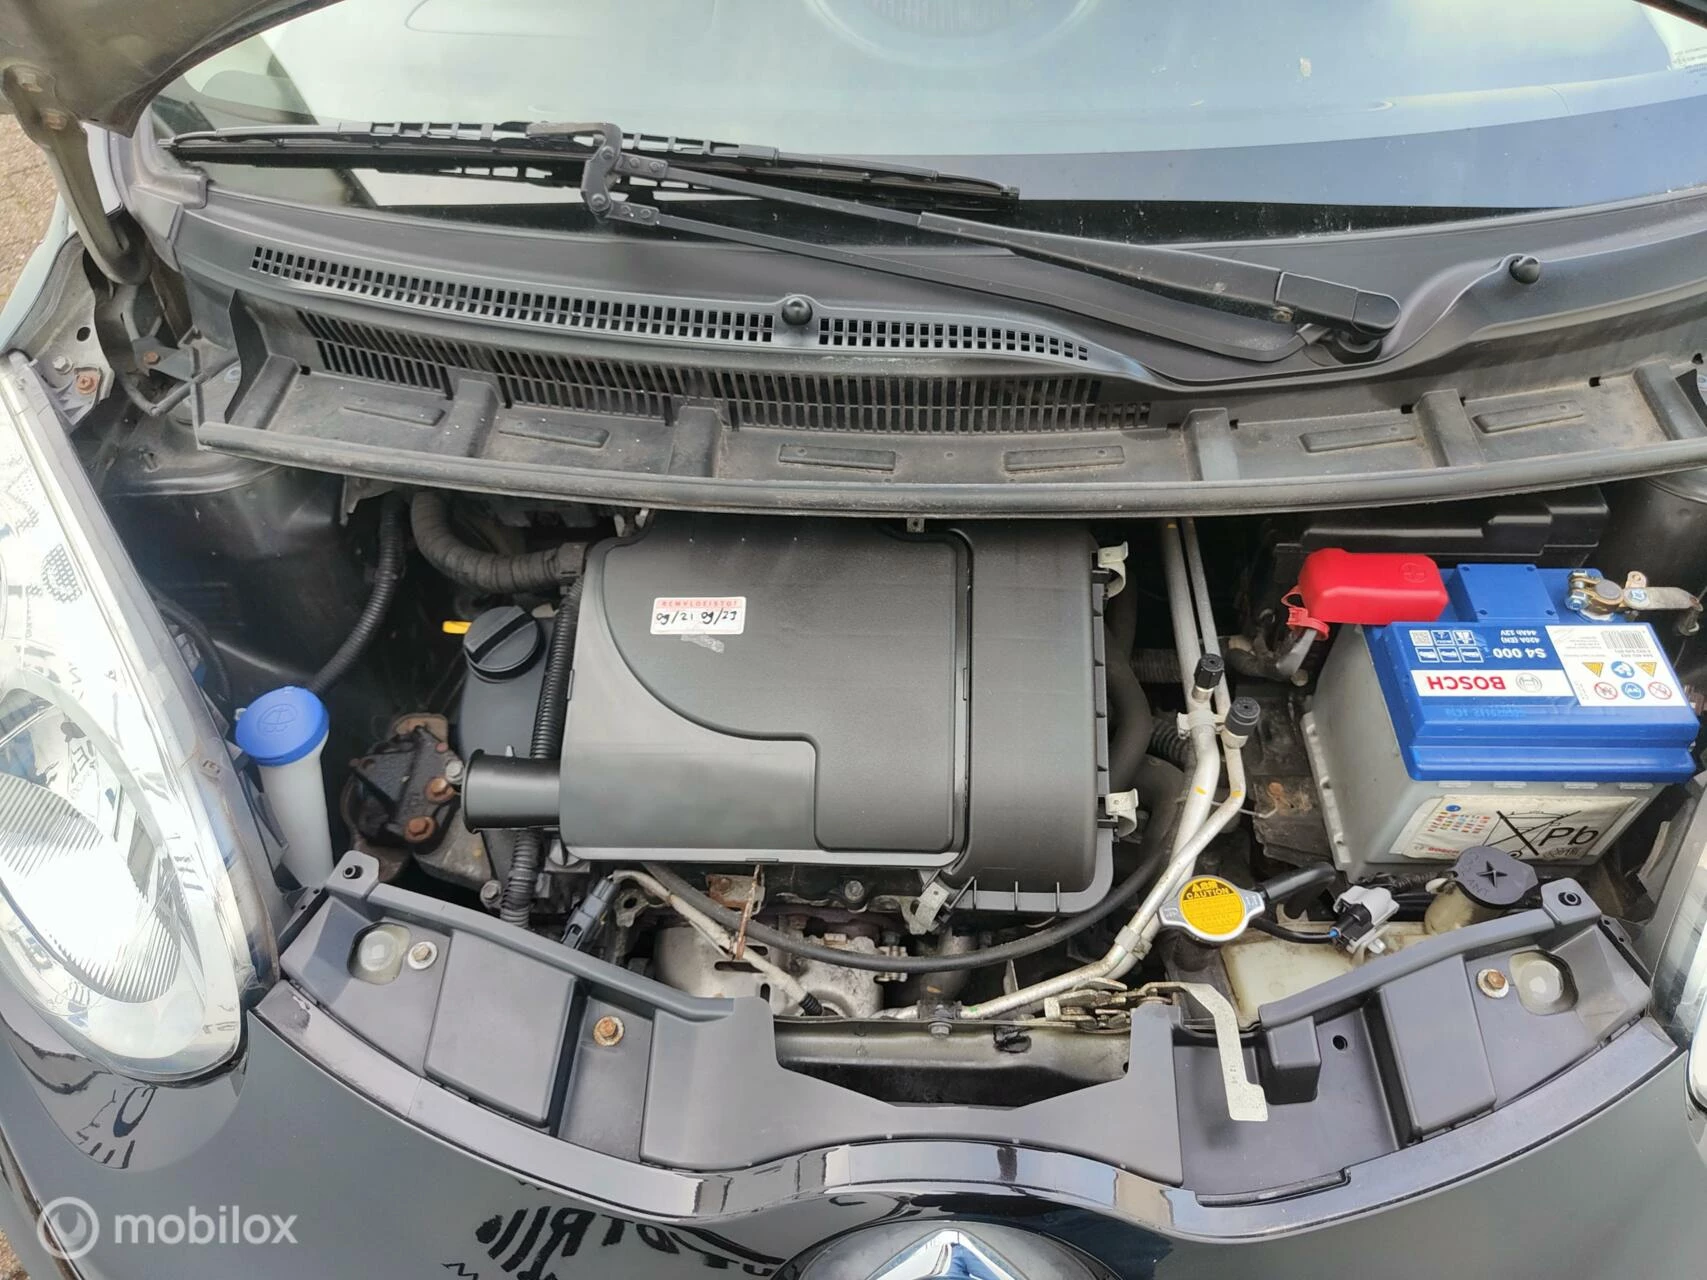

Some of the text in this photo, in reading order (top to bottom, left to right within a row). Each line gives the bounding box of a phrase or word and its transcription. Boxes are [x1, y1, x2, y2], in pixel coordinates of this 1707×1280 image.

[1492, 647, 1547, 659] S4 000
[1427, 676, 1505, 690] BOSCH
[1538, 825, 1599, 846] Pb
[1185, 887, 1230, 900] CAUTION
